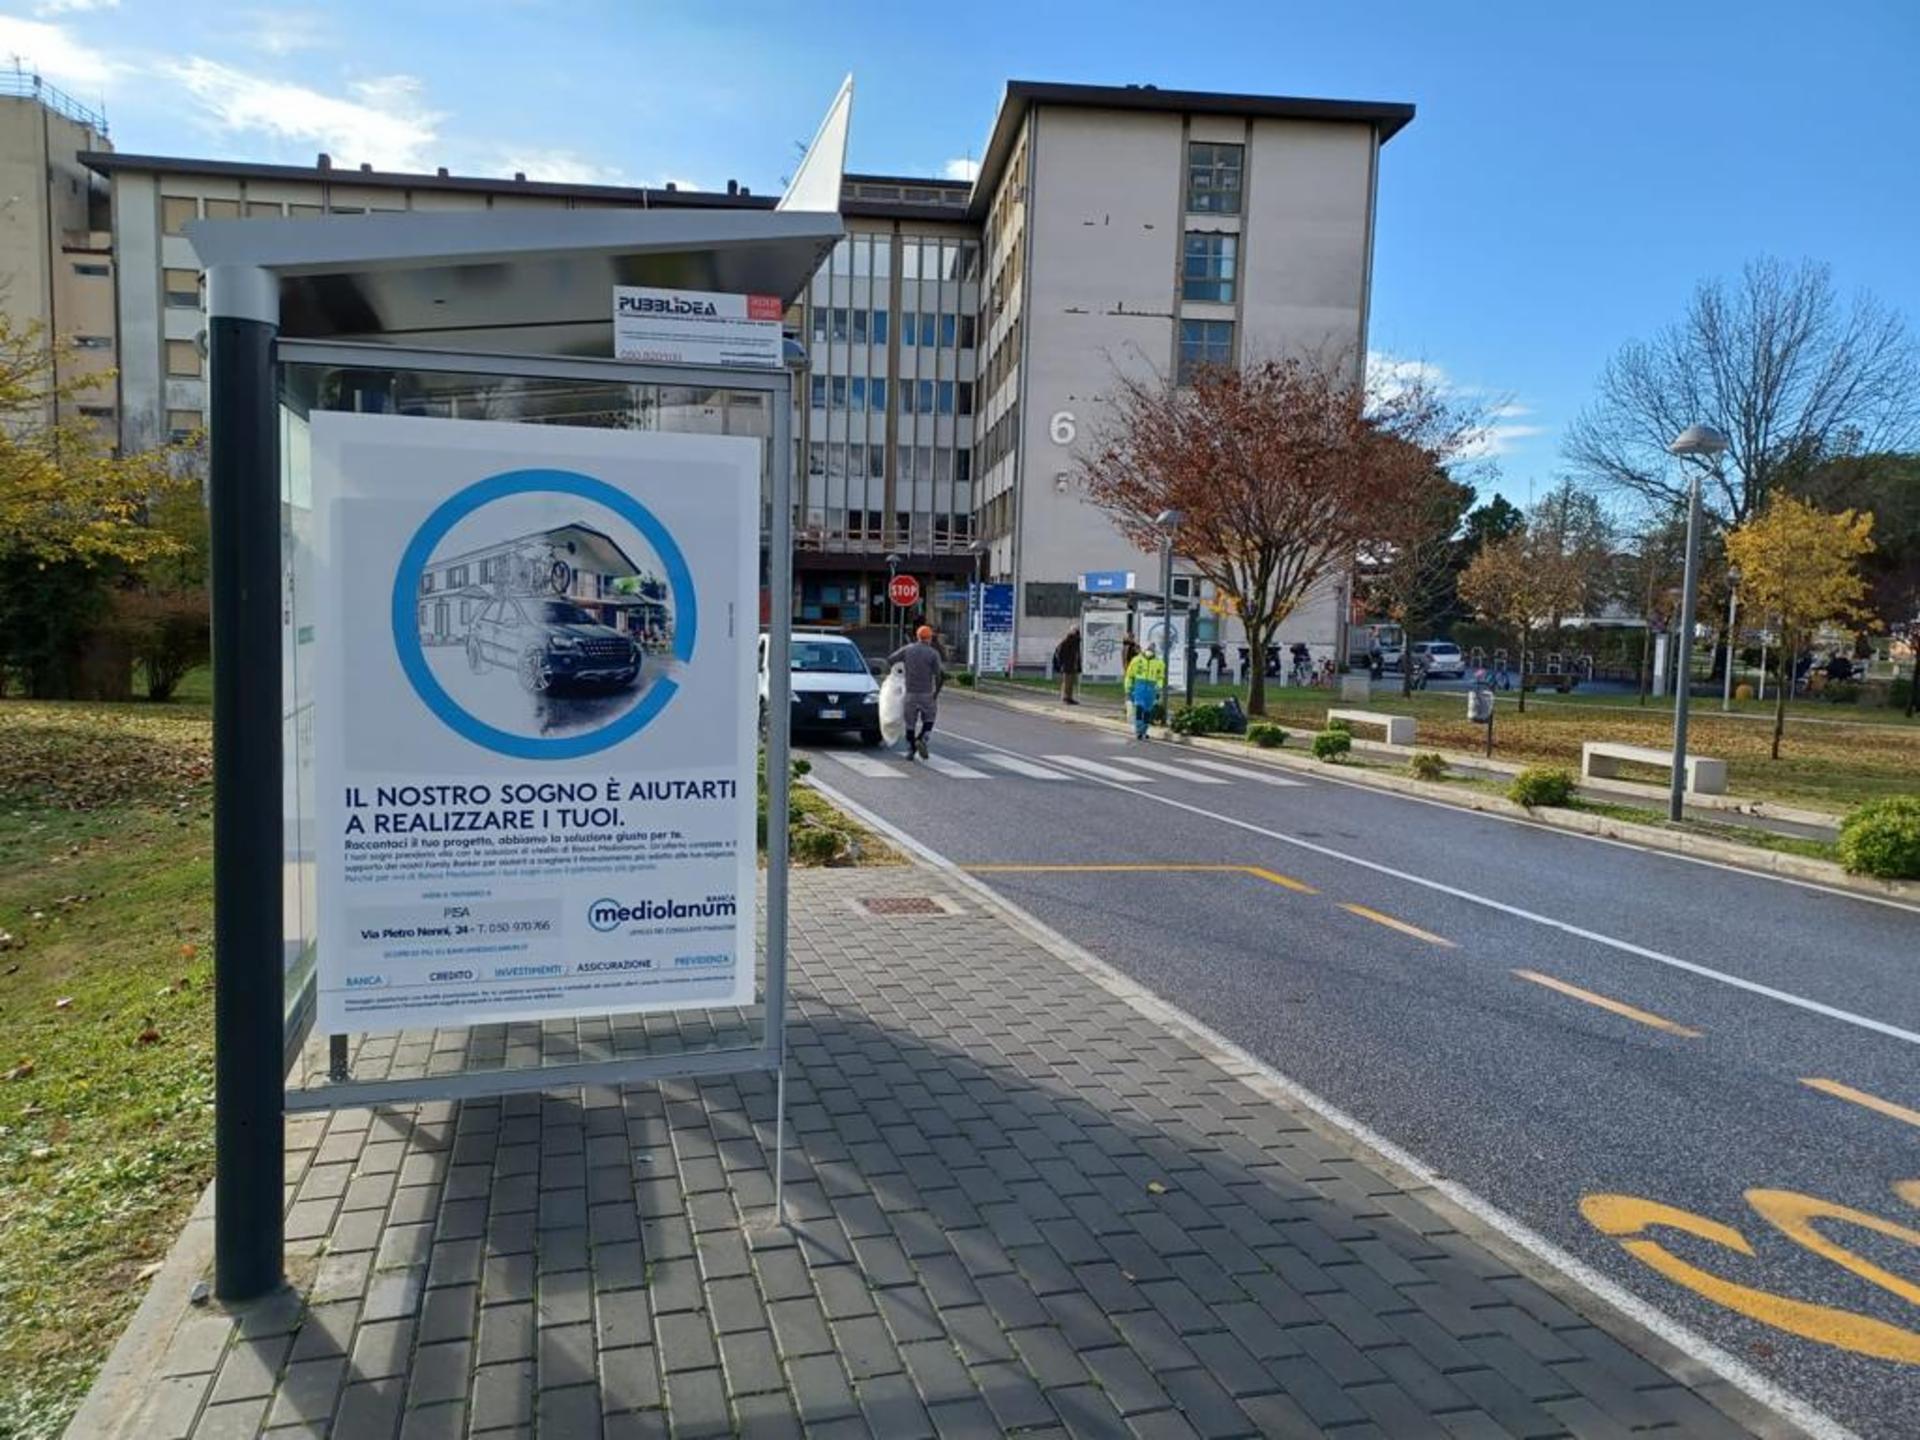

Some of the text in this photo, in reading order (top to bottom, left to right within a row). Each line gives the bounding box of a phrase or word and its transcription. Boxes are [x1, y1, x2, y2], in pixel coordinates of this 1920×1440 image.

[1050, 411, 1076, 444] 6
[891, 584, 918, 597] STOP
[345, 776, 736, 808] IL NOSTRO SOGNO È AIUTARTI
[345, 807, 626, 835] A REALIZZARE I TUOI.
[344, 838, 408, 851] Raccontaci
[420, 837, 441, 849] tuo
[443, 835, 495, 850] progetto,
[498, 834, 549, 847] abbiamo
[550, 833, 562, 844] la
[564, 832, 613, 845] soluzione
[615, 831, 648, 844] giusta
[650, 831, 667, 842] per
[595, 899, 736, 923] mediolanum
[360, 928, 380, 940] Via
[382, 927, 415, 939] Pietro
[345, 954, 729, 987] BANCA CREDITO INVESTIMENTI ASSICURAZIONE PREVIDENZA
